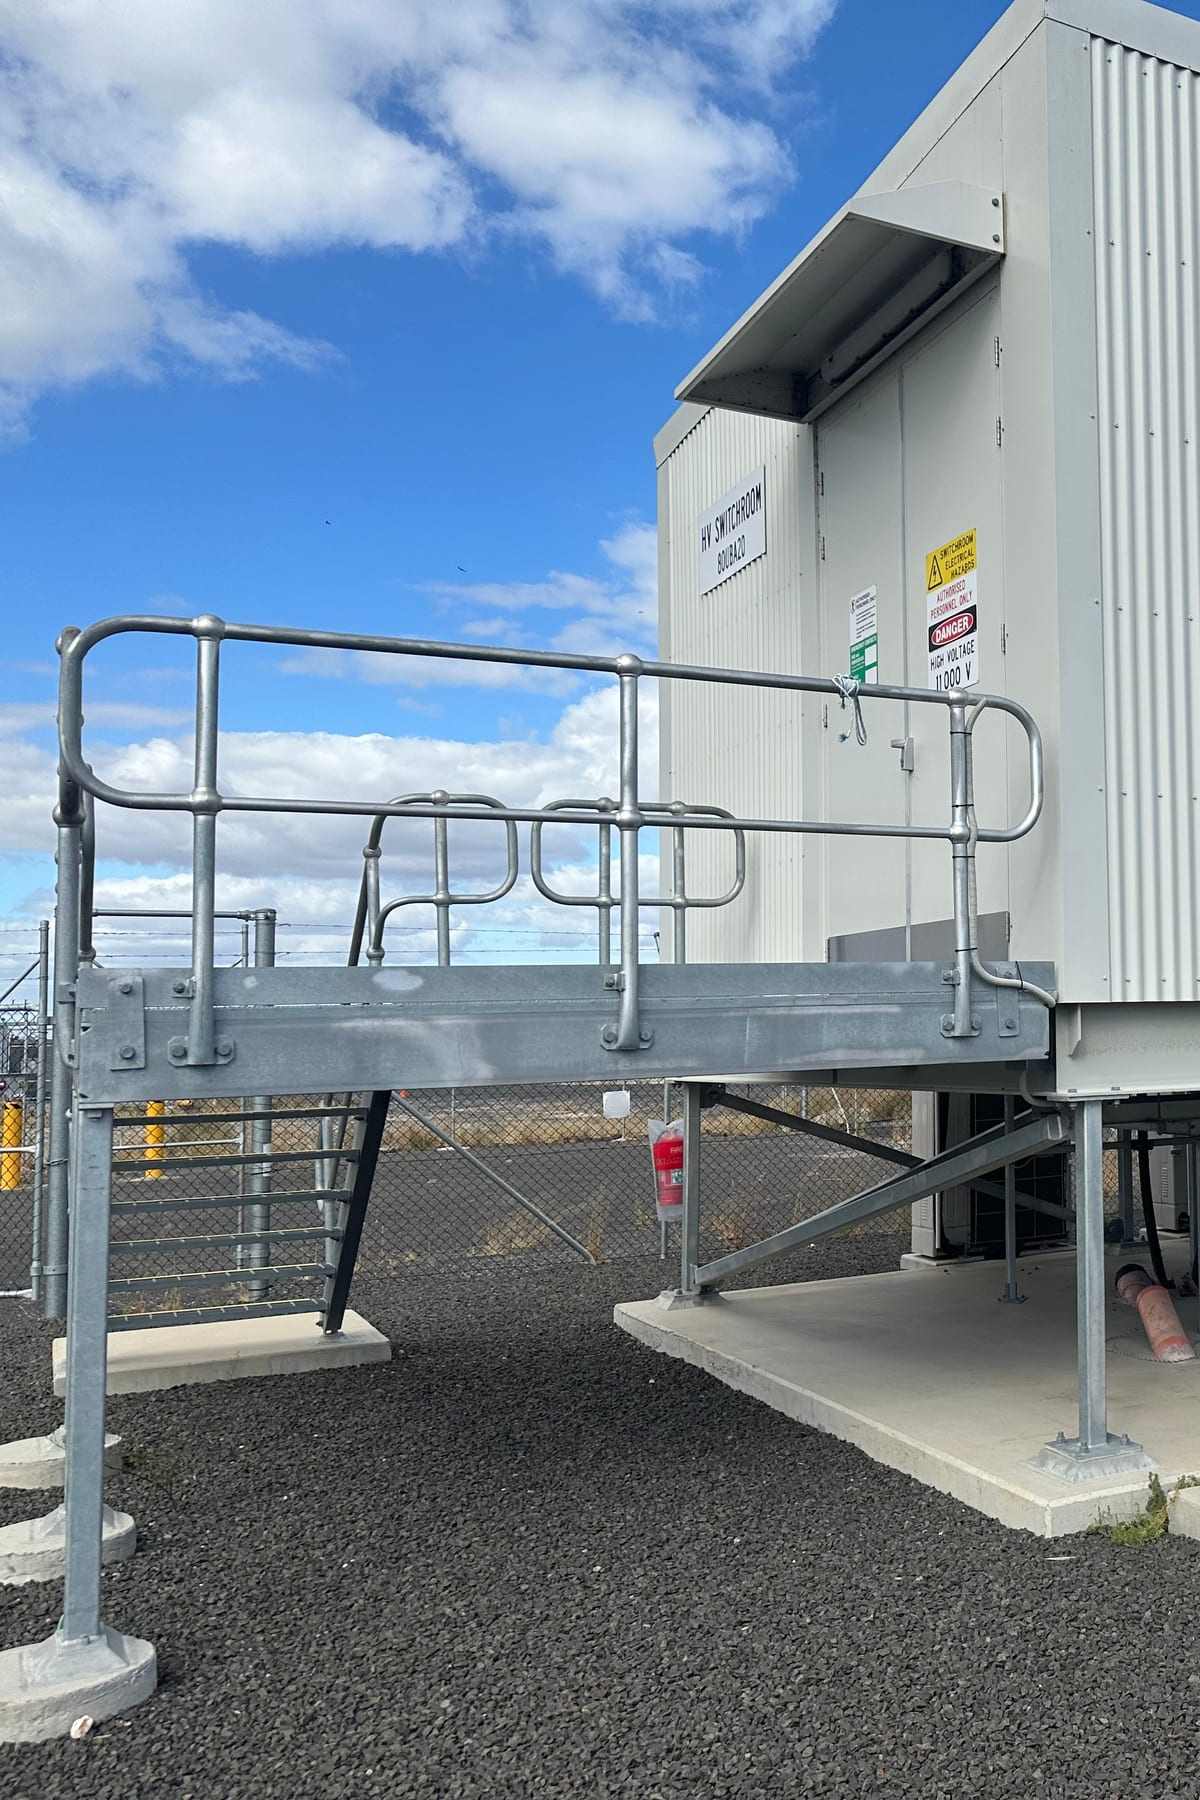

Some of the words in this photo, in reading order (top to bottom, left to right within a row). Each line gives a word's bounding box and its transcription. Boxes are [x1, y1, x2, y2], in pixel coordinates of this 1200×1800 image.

[701, 522, 712, 553] HV
[715, 482, 762, 543] SWITCHROOM
[717, 534, 746, 575] 80UBA20
[940, 533, 974, 560] SWITCHROOM
[944, 549, 975, 571] ELECTRICAL
[950, 559, 975, 579] HAZARDS
[936, 579, 966, 603] AUTHORISED
[930, 598, 957, 620] PERSONNEL
[959, 591, 973, 608] ONLY
[935, 616, 969, 643] DANGER
[930, 653, 944, 672] HIGH
[947, 640, 975, 663] VOLTAGE
[965, 661, 971, 681] V
